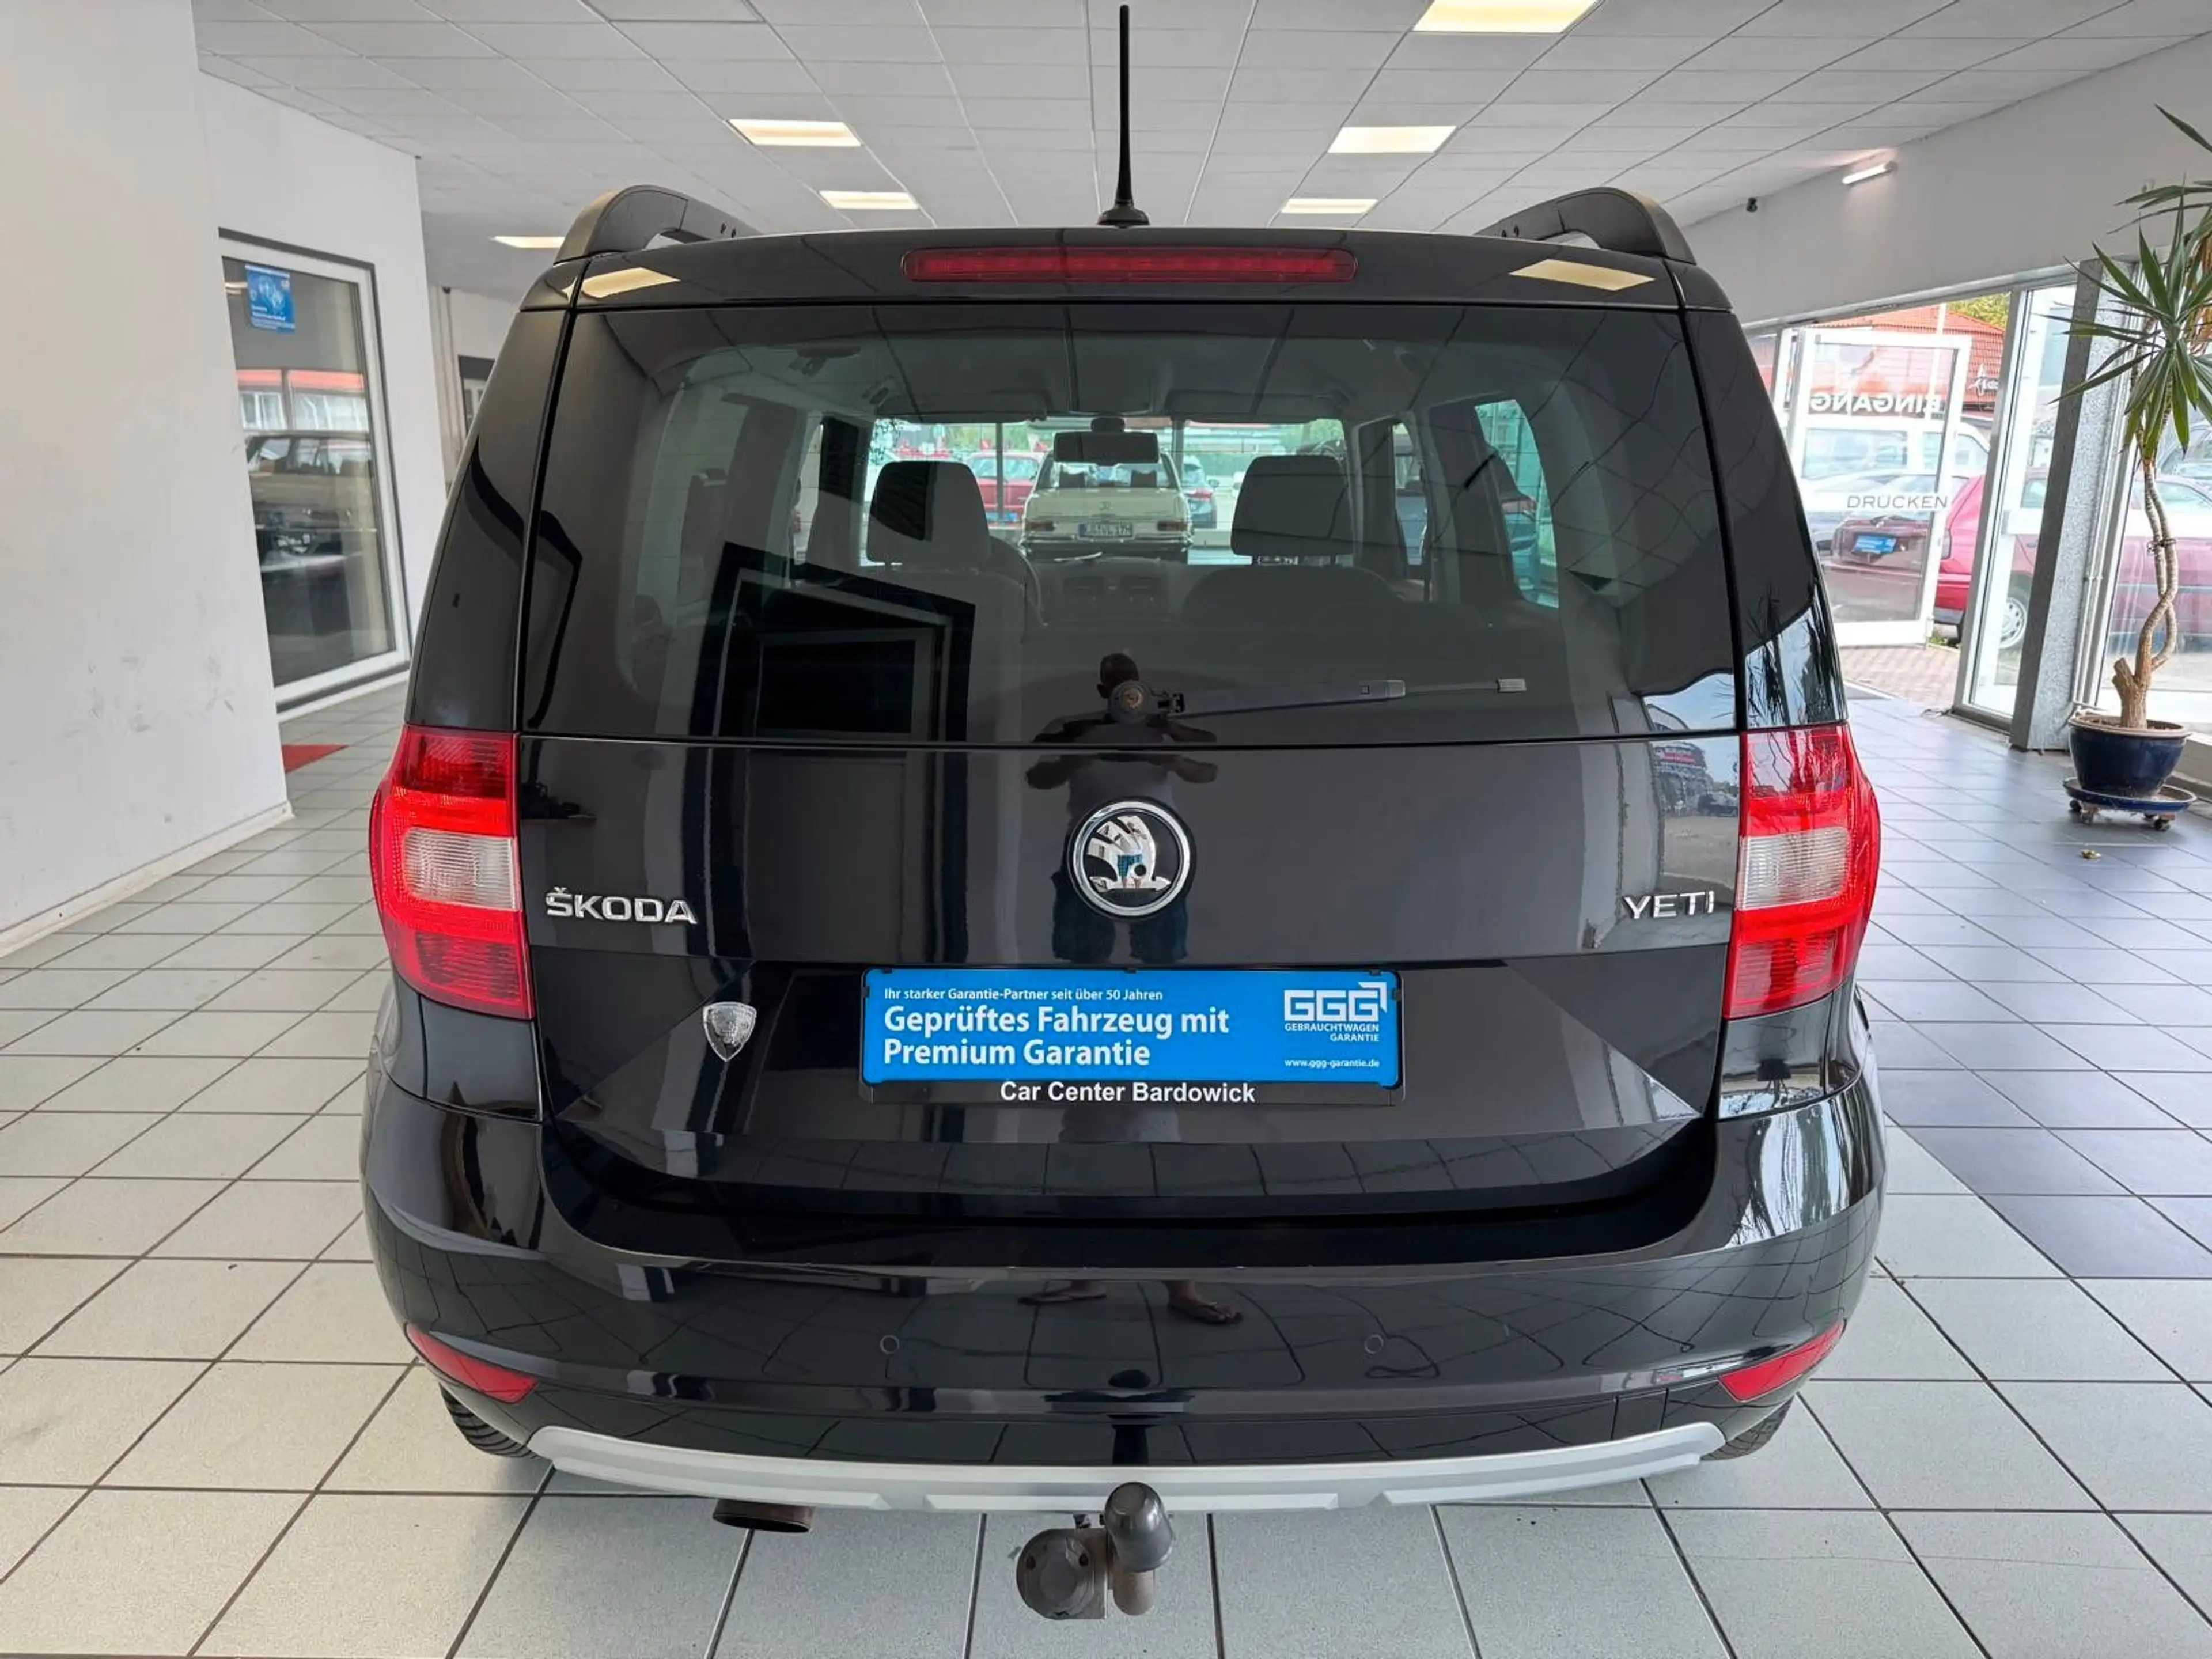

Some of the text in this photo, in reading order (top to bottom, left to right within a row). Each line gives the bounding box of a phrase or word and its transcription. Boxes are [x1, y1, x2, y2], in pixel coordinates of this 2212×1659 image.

[1847, 494, 1948, 509] DRÜCKEN
[546, 886, 698, 925] ŠKODA
[1623, 890, 1714, 919] YETI
[884, 988, 1162, 1001] Ihr starker Garantie-Partner seit über 50 Jahren
[884, 1005, 1229, 1040] Geprüftes Fahrzeug mit
[1285, 1022, 1380, 1032] GEBRAUCHTWAGEN
[1330, 1033, 1380, 1042] GARANTIE
[884, 1038, 1150, 1065] Premium Garantie
[1284, 1059, 1380, 1069] www.ggg-garantie.de
[1001, 1081, 1256, 1103] Car Center Bardowick
